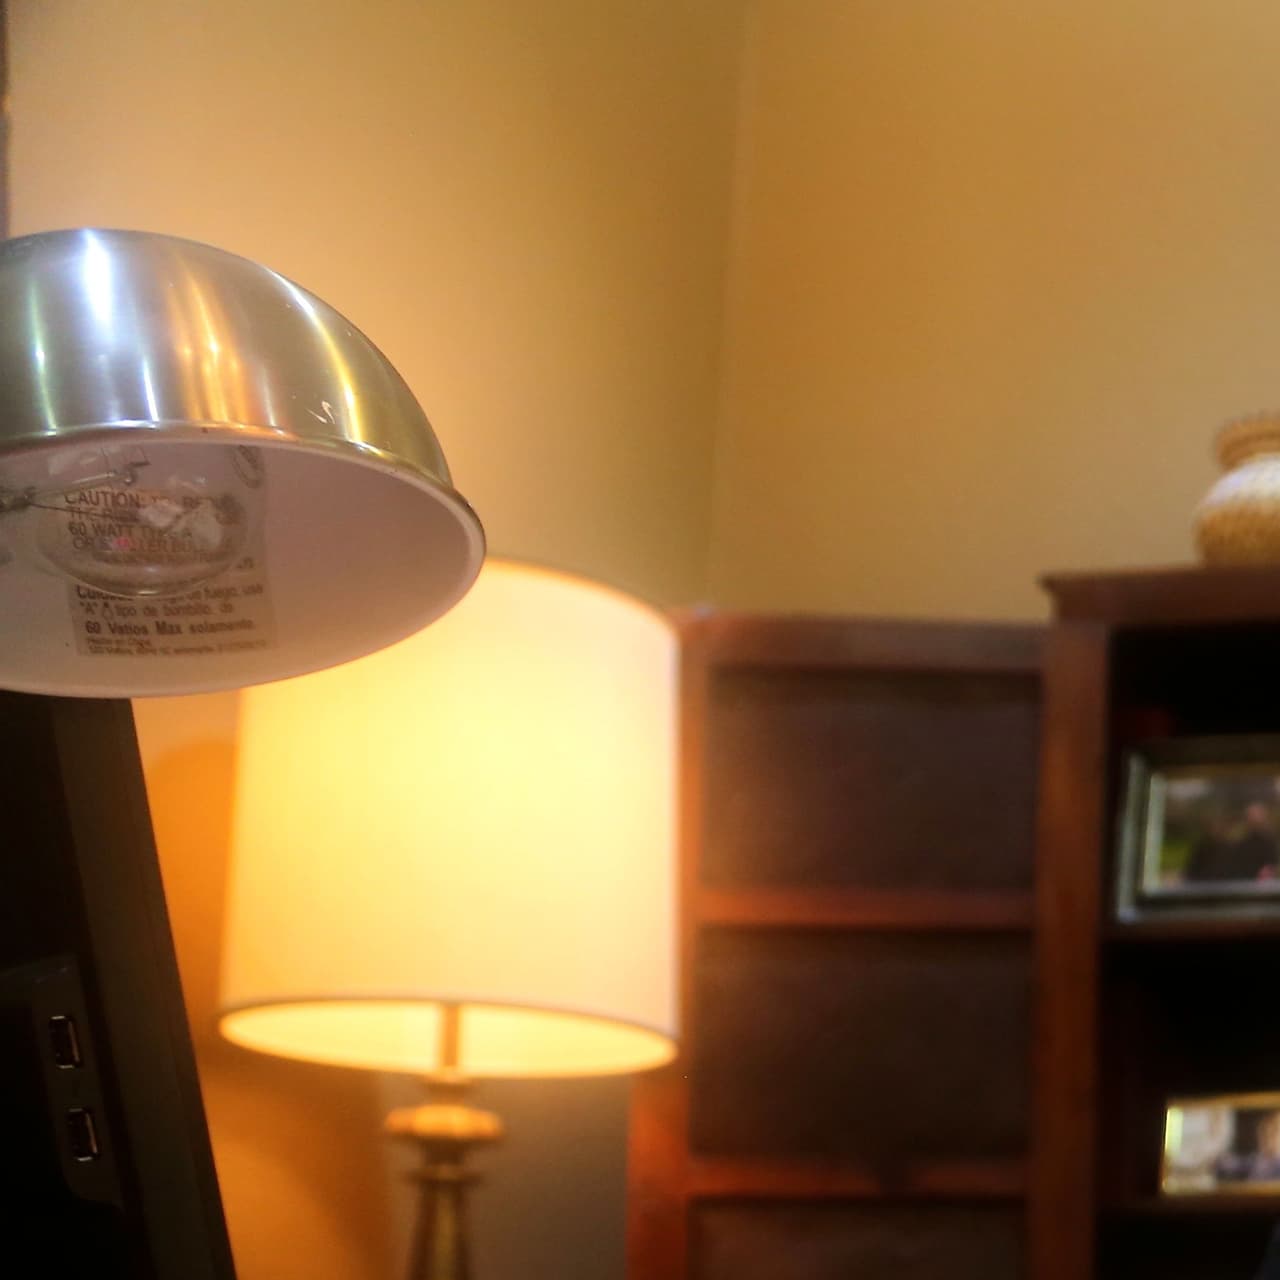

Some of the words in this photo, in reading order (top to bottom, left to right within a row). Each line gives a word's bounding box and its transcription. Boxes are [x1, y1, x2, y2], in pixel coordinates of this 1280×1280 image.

[68, 522, 86, 536] 60
[85, 620, 100, 634] 60
[108, 621, 149, 635] Vatios
